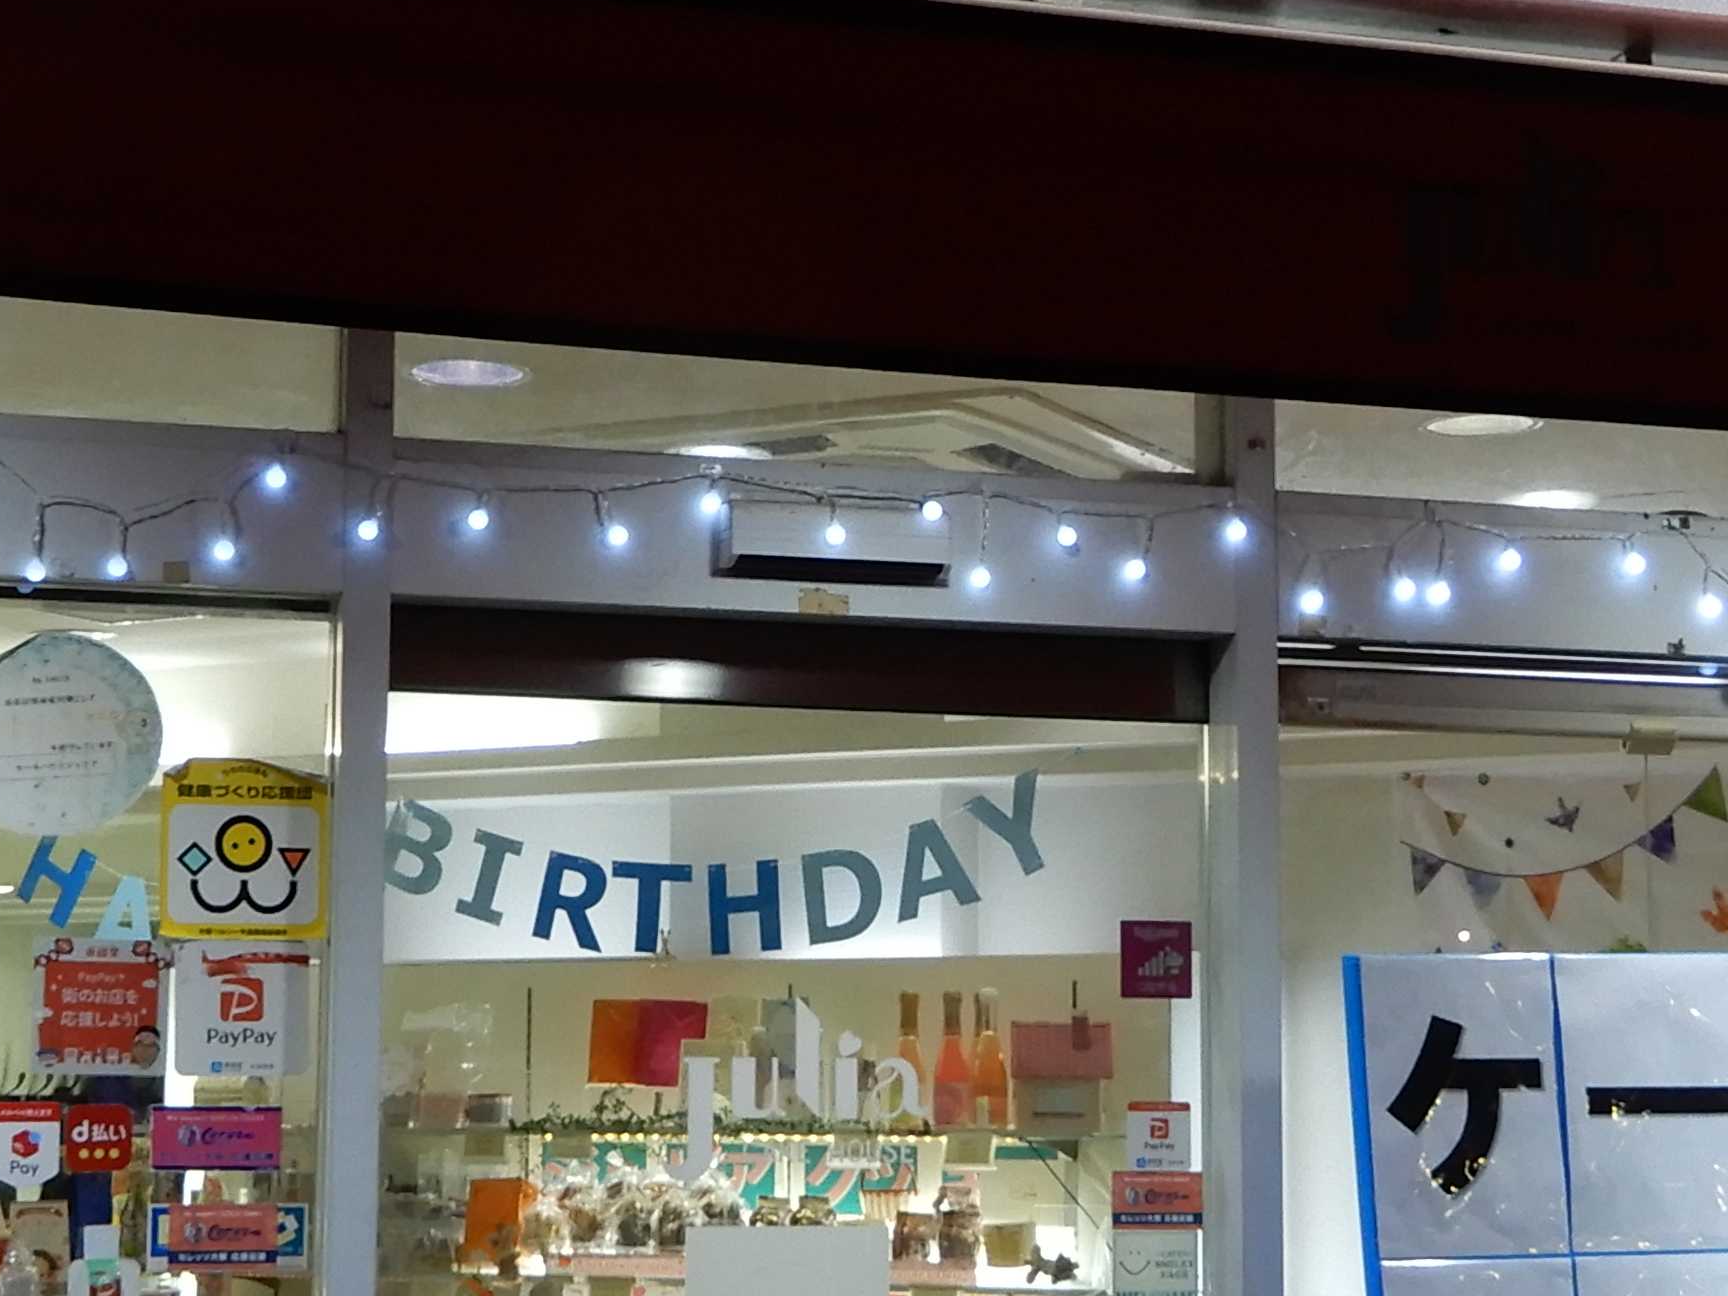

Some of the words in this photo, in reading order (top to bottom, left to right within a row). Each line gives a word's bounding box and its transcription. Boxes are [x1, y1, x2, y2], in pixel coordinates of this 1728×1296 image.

[177, 783, 313, 800] 健康づくり応援団
[385, 770, 1045, 956] BIRTHDAY
[206, 1027, 278, 1048] PayPay
[666, 997, 929, 1181] Julia
[72, 1119, 127, 1143] d払い
[10, 1159, 40, 1176] Pay
